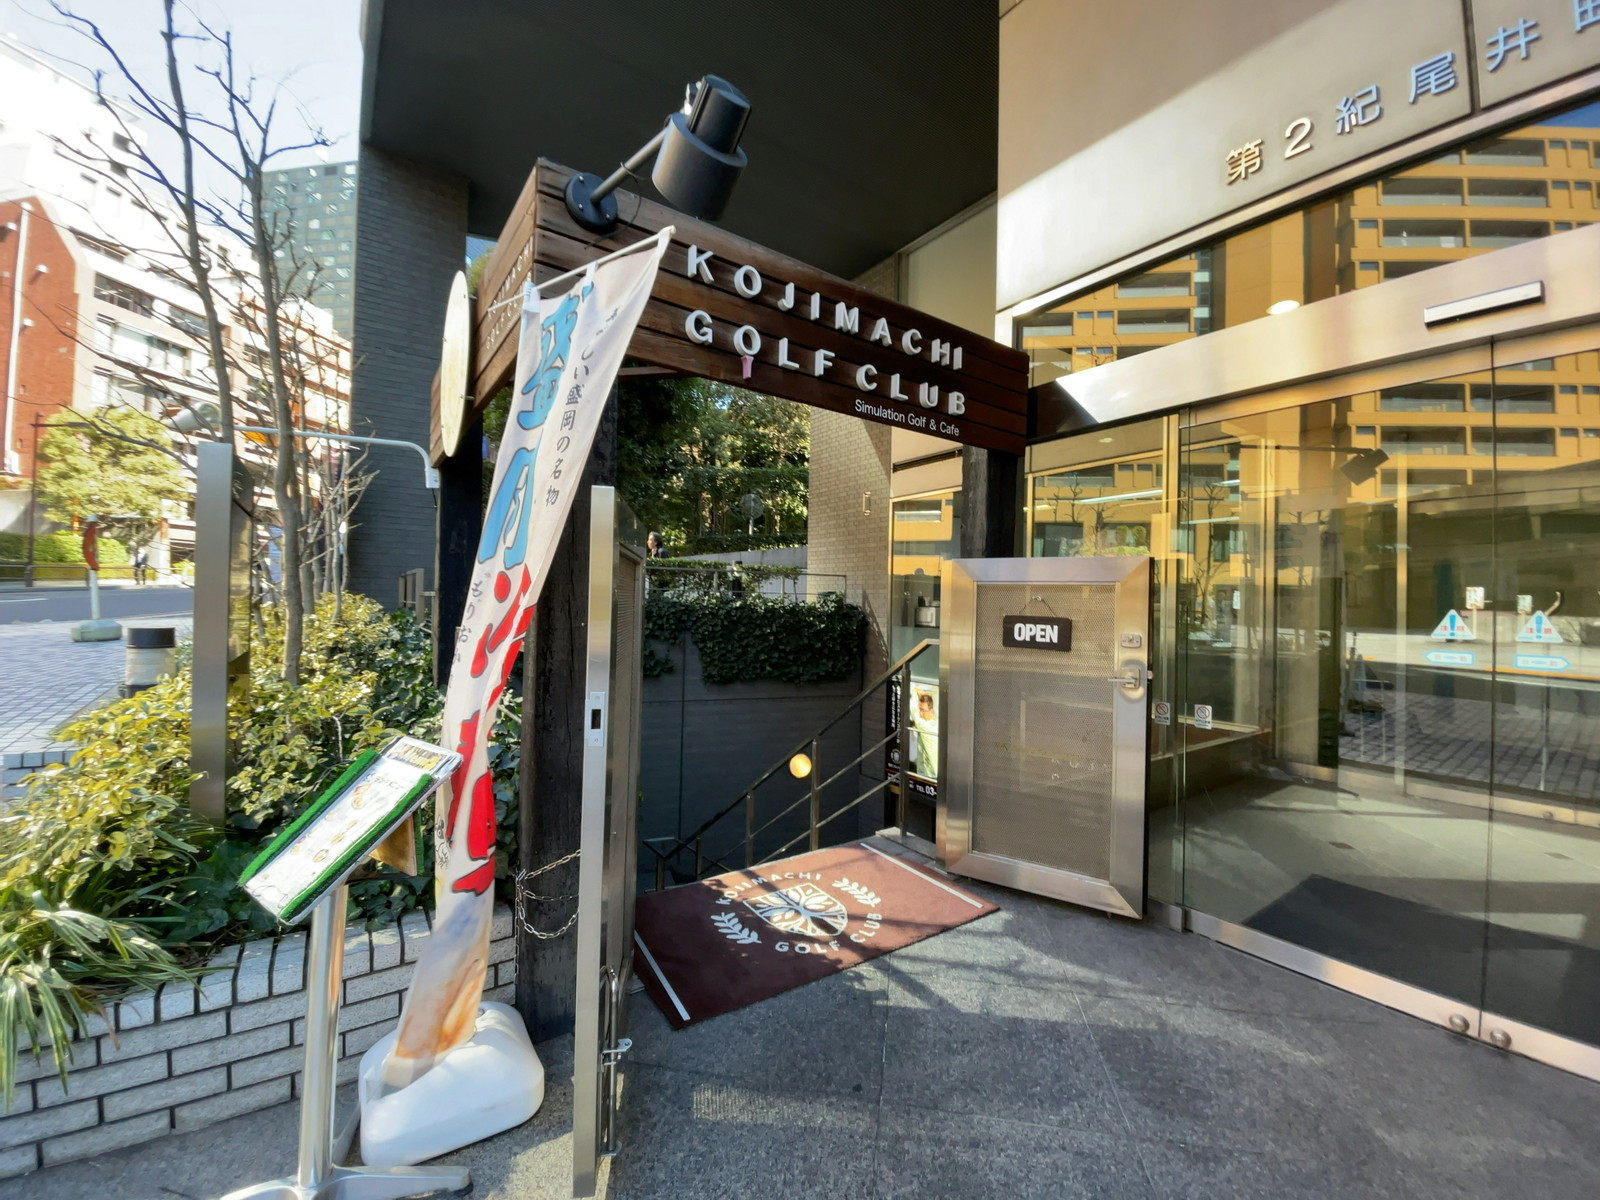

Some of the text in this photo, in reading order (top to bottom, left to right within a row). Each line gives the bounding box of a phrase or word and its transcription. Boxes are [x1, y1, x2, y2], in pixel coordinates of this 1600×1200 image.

[687, 244, 963, 371] KOJIMACHI
[685, 309, 966, 417] GOLF CLUB
[545, 305, 619, 508] しい盛岡の名物
[854, 399, 960, 436] Simulation Golf & Cafe
[1013, 622, 1058, 643] OPEN
[715, 871, 822, 906] KOJIMACHI
[850, 912, 882, 943] CLUB
[774, 939, 841, 954] GOLF
